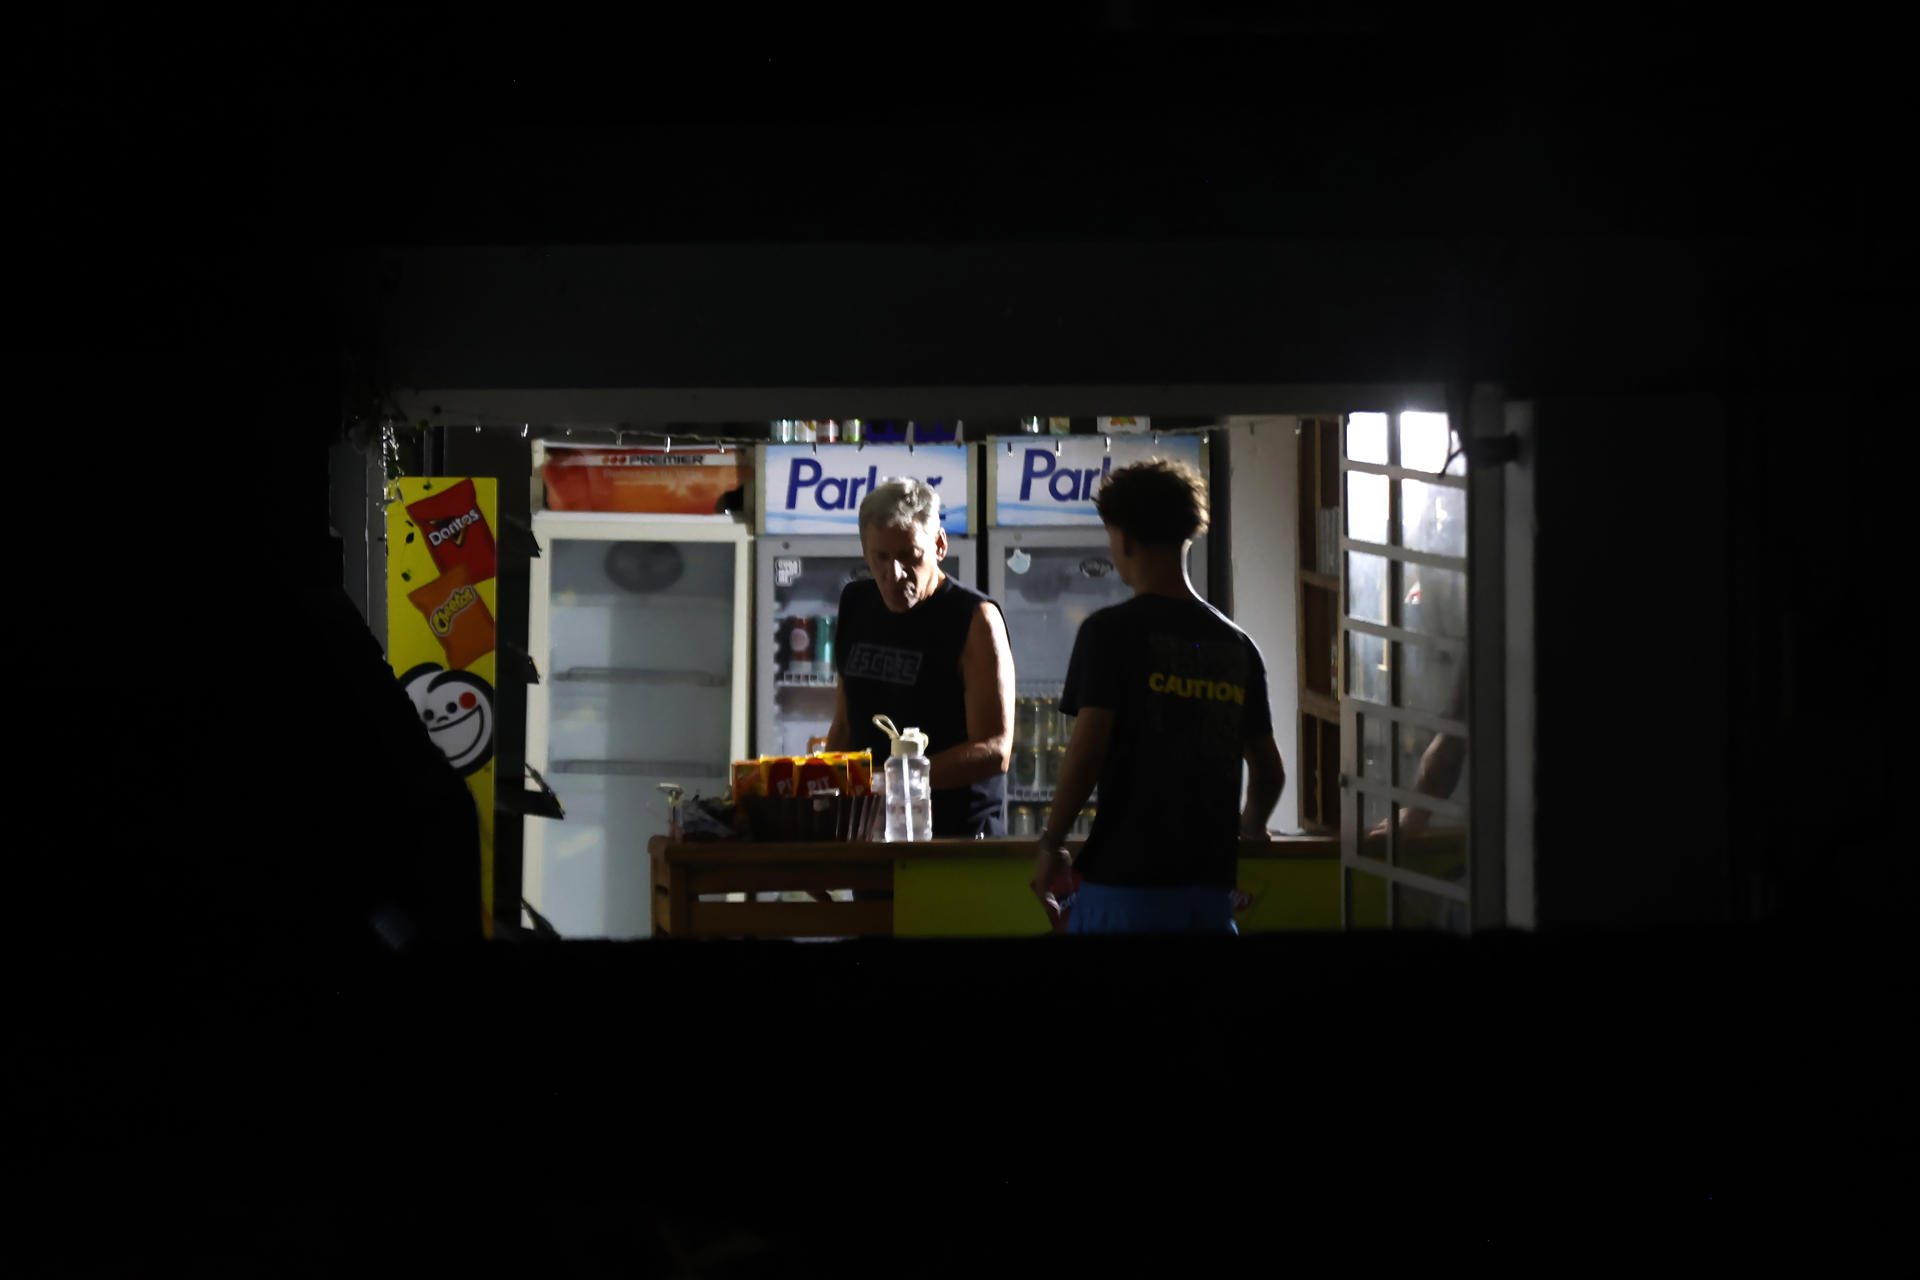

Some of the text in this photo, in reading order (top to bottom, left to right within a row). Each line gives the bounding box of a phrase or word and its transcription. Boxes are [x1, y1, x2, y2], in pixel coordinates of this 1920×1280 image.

[629, 454, 704, 466] PREMIER
[785, 457, 943, 511] Parr
[428, 508, 480, 546] Doritos
[1148, 671, 1246, 706] CAUTION
